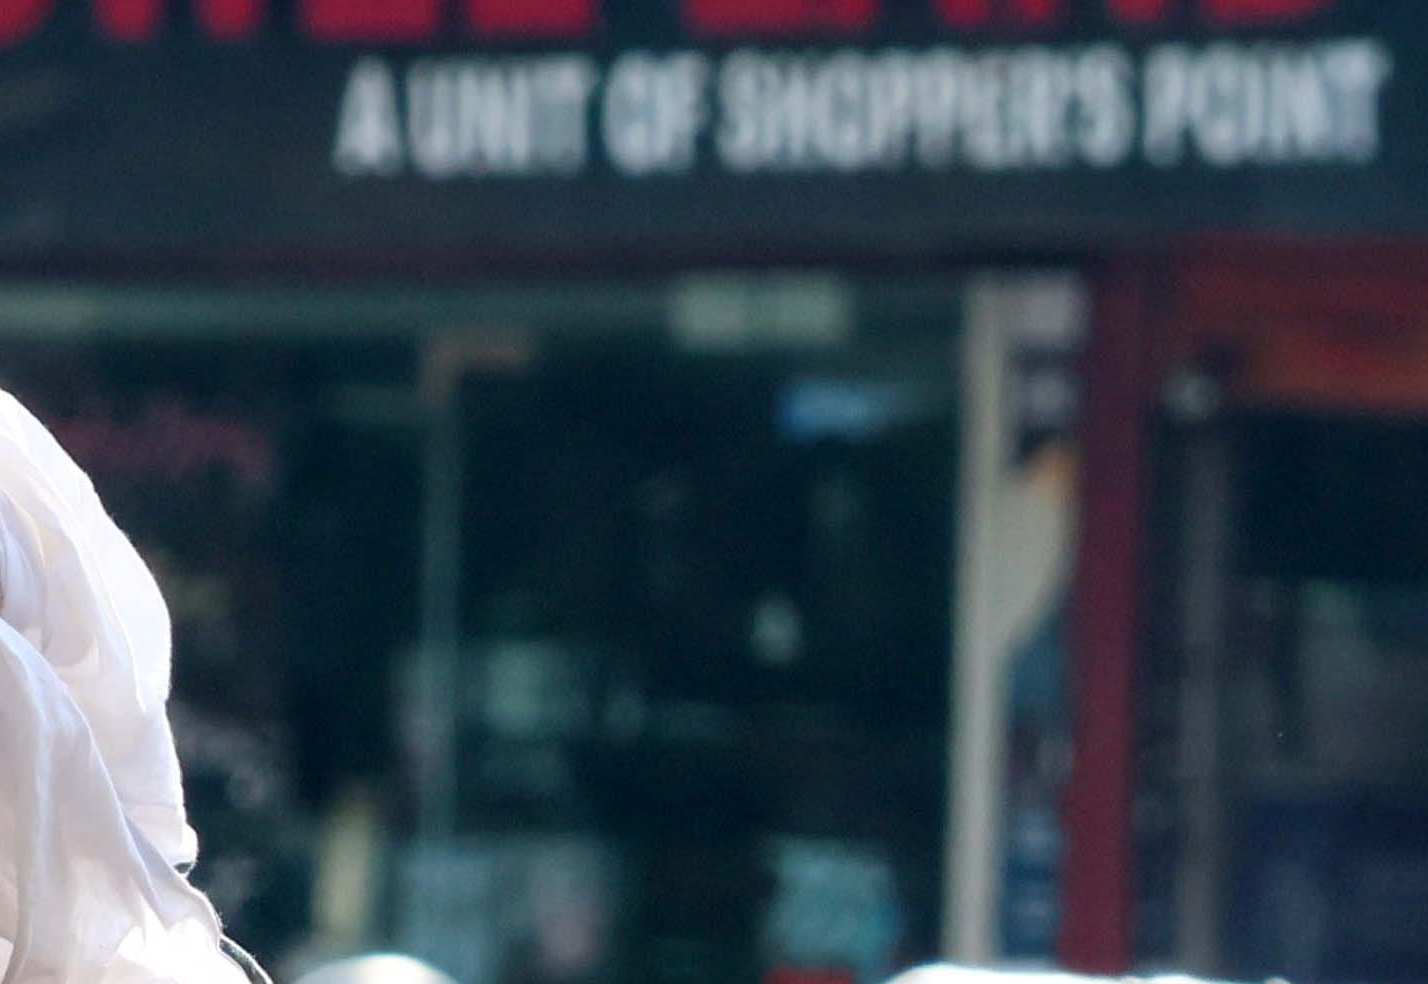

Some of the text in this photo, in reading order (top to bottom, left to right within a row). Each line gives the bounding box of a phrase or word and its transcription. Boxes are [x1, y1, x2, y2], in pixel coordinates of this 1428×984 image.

[335, 39, 1388, 174] A UNIT OF SHOPPER'S POINT
